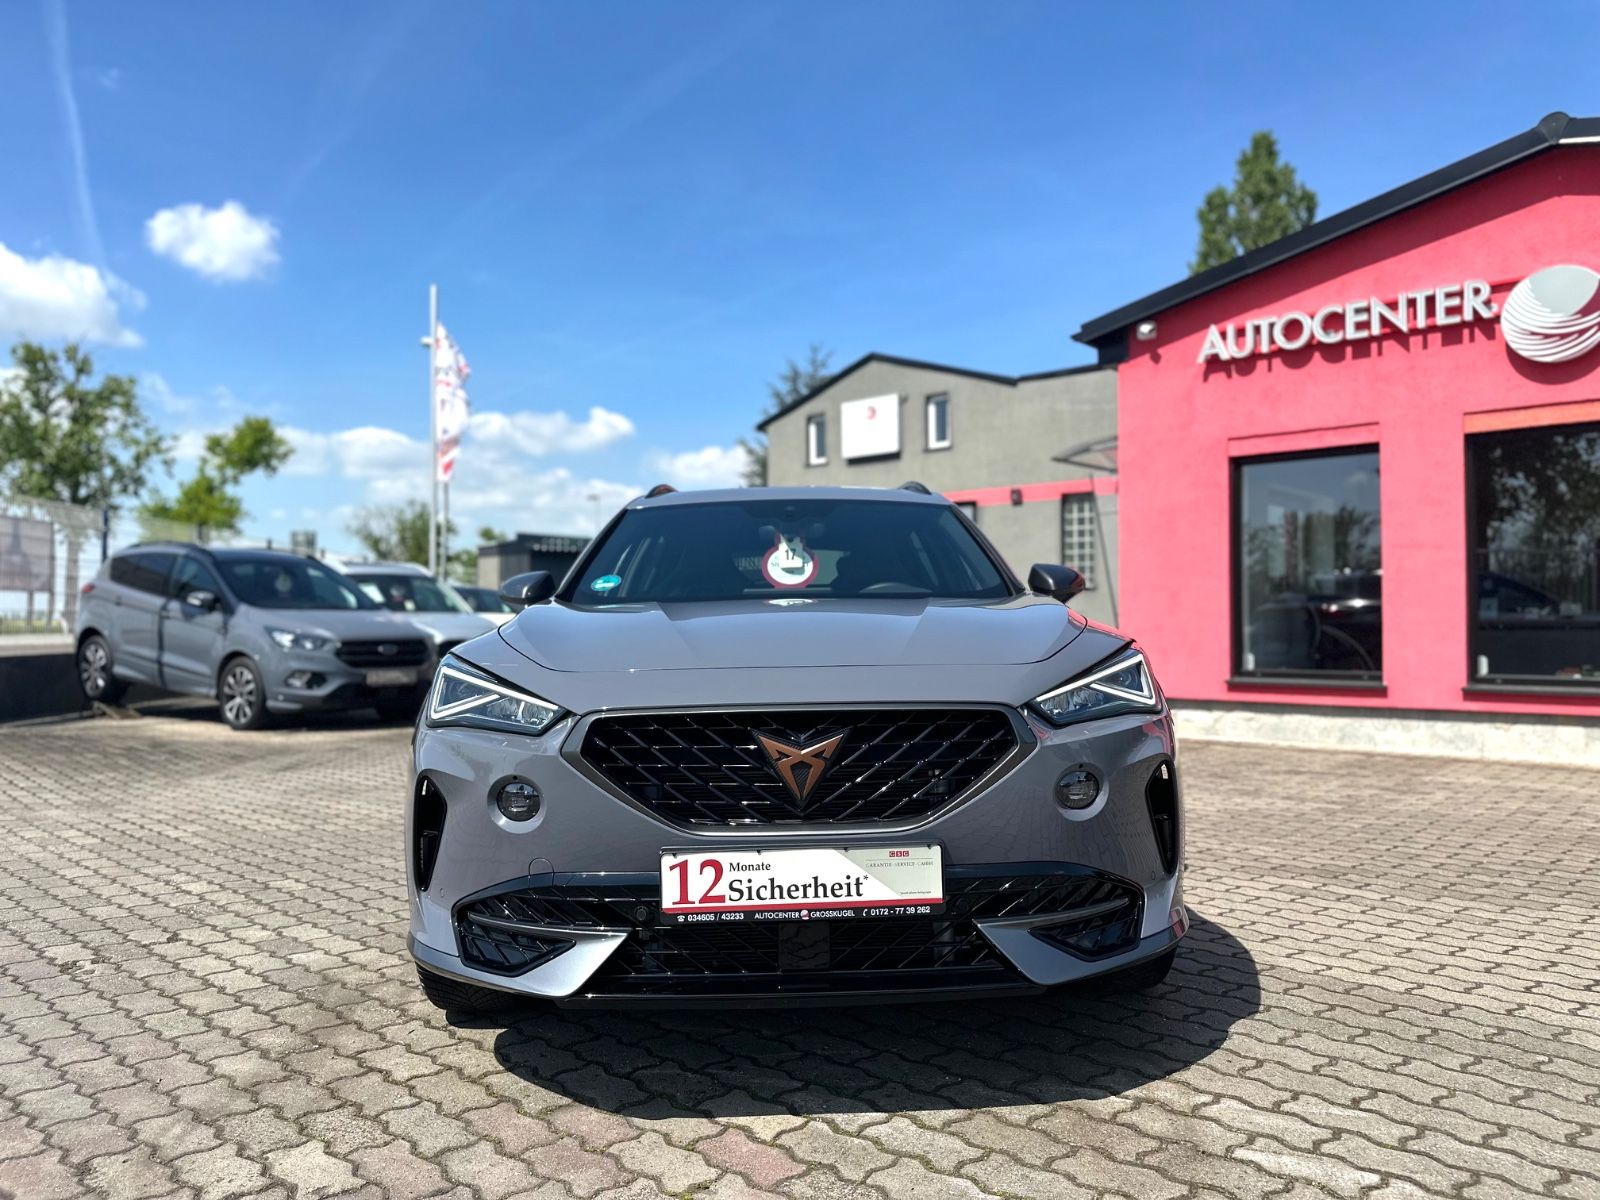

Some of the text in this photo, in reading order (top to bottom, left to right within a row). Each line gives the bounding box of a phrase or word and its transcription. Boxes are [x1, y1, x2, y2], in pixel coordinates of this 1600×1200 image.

[1197, 278, 1496, 363] AUTOCENTER
[785, 549, 796, 560] 17
[729, 862, 771, 872] Monate
[669, 859, 725, 904] 12
[687, 914, 715, 922] 034605
[721, 912, 745, 920] 43233
[754, 911, 800, 919] AUTOCENTER
[810, 910, 855, 918] GROSSKUGEL
[870, 908, 889, 916] 0172
[895, 907, 905, 915] 77
